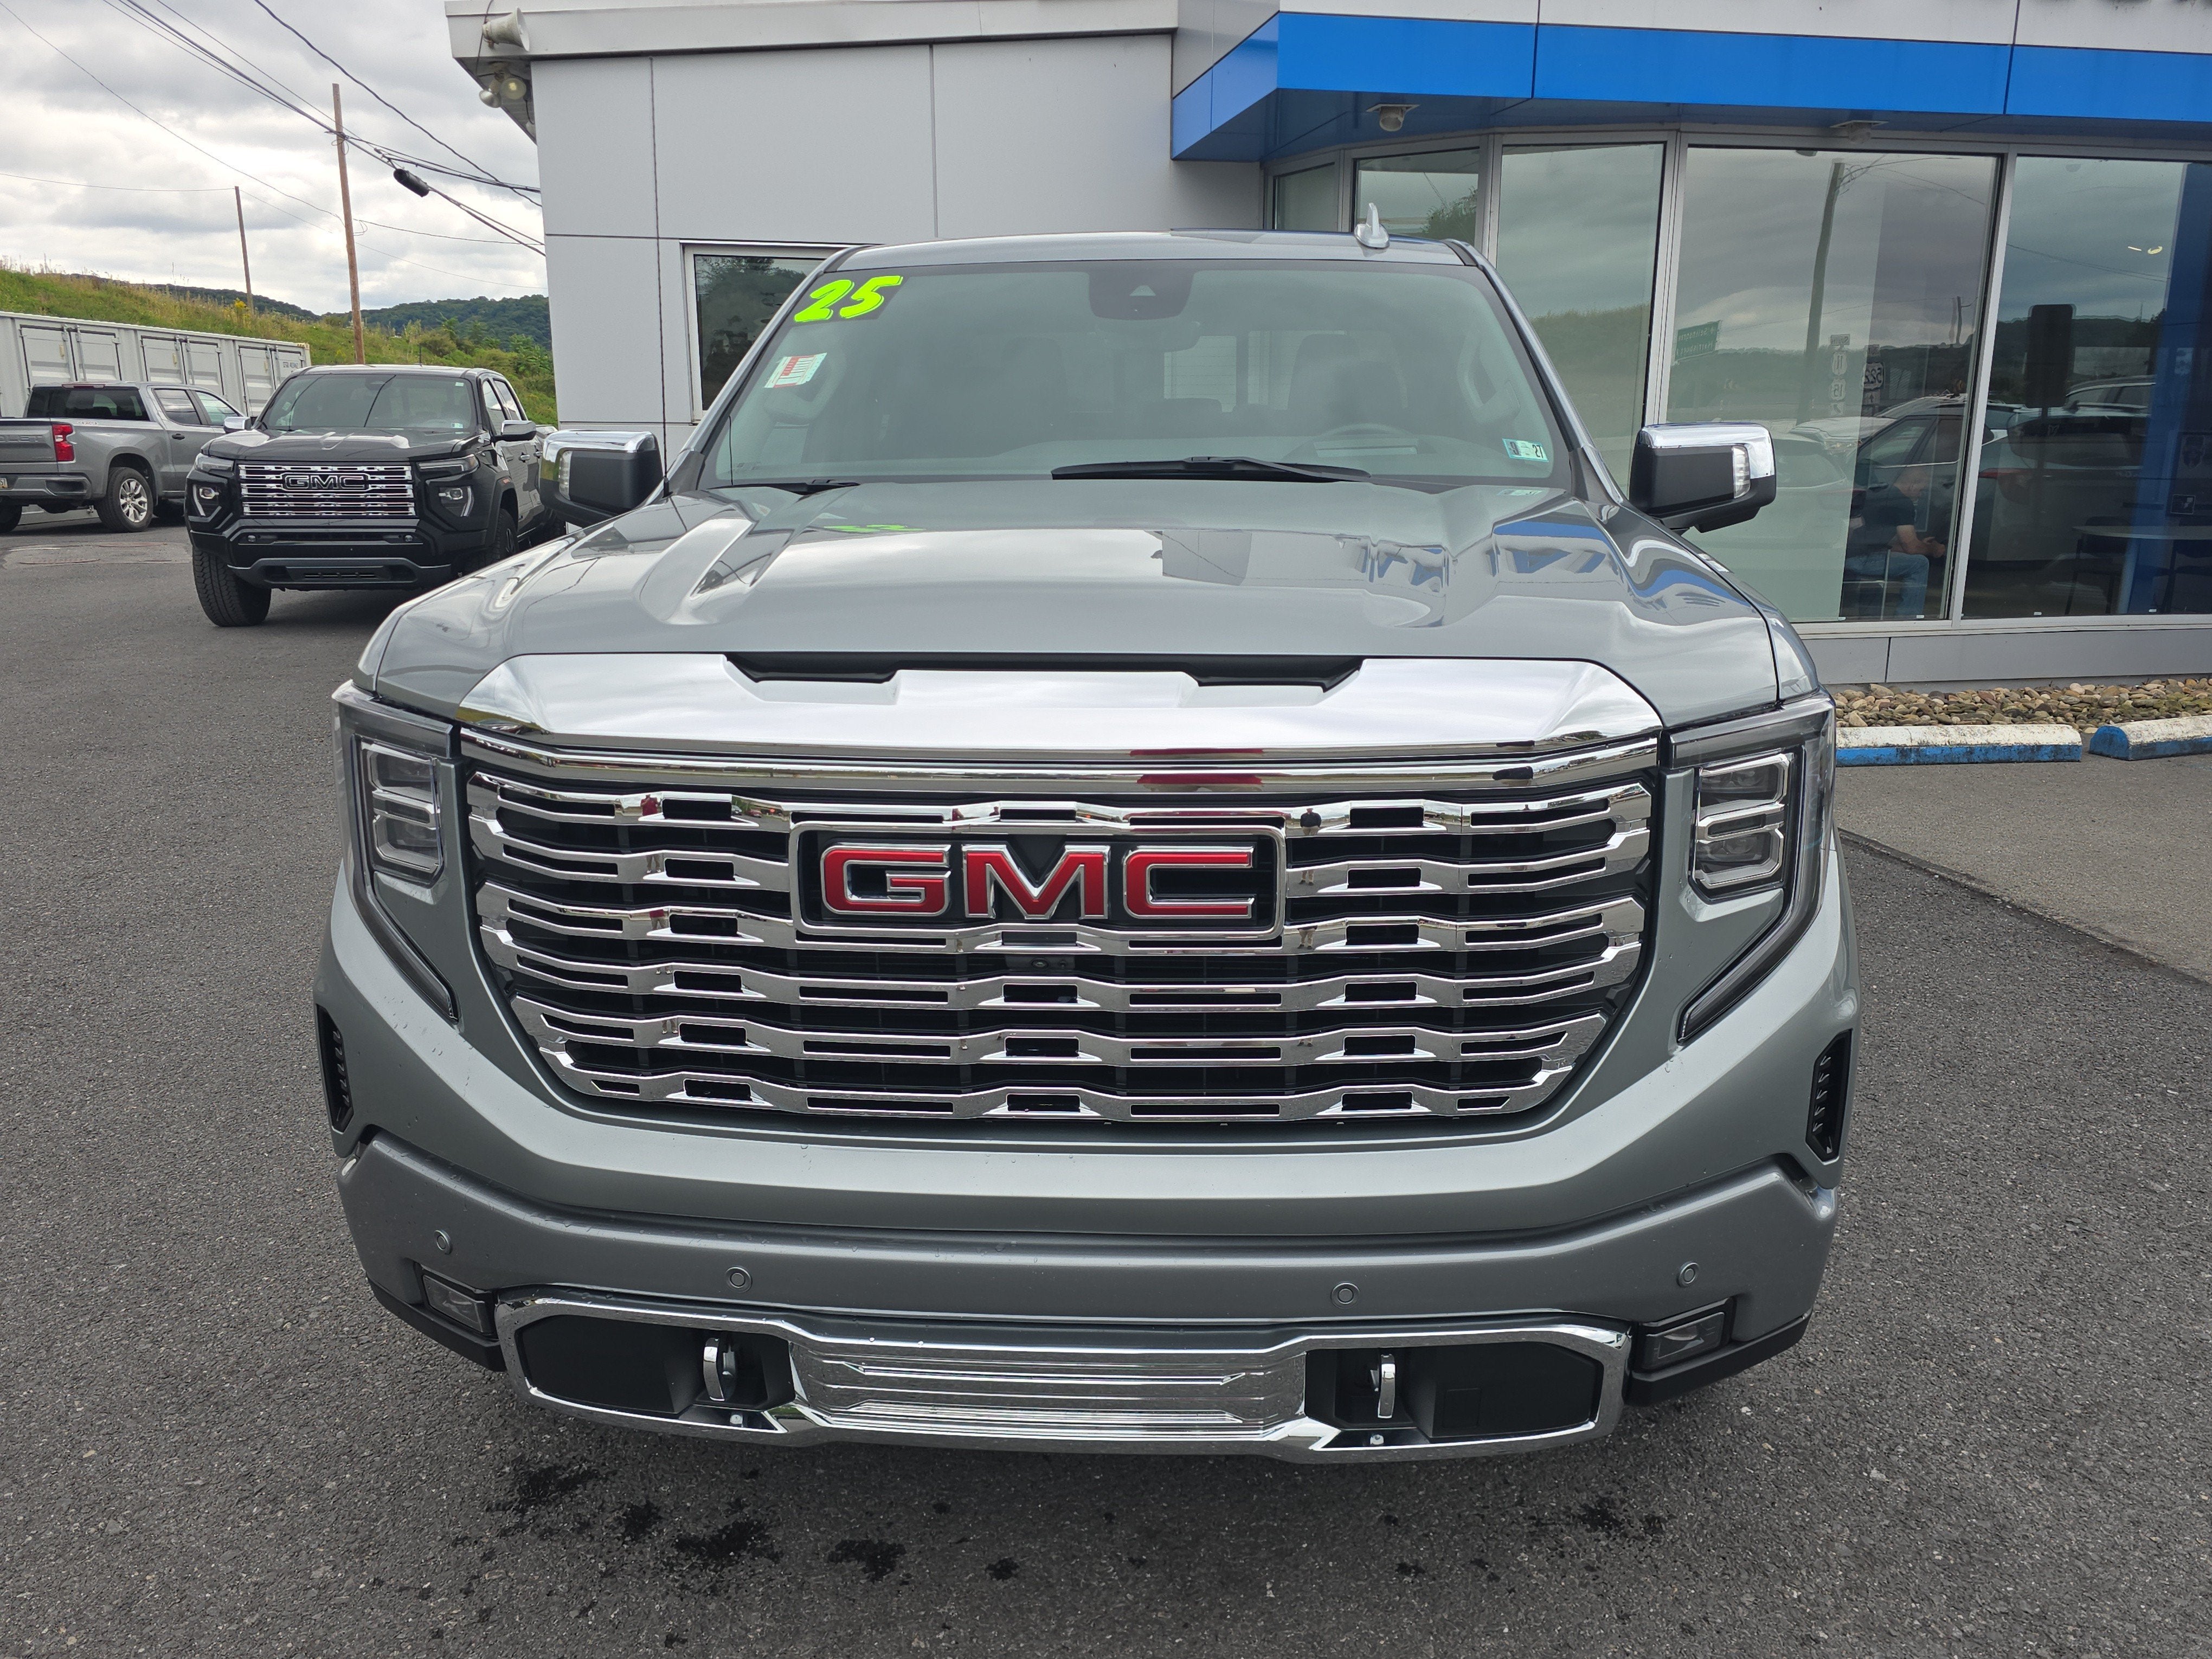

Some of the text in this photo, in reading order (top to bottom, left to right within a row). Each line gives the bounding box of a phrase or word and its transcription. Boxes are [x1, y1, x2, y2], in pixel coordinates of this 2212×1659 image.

[794, 276, 903, 322] 25
[1532, 445, 1544, 458] 27
[285, 475, 365, 489] GMC
[821, 843, 1255, 919] GMC
